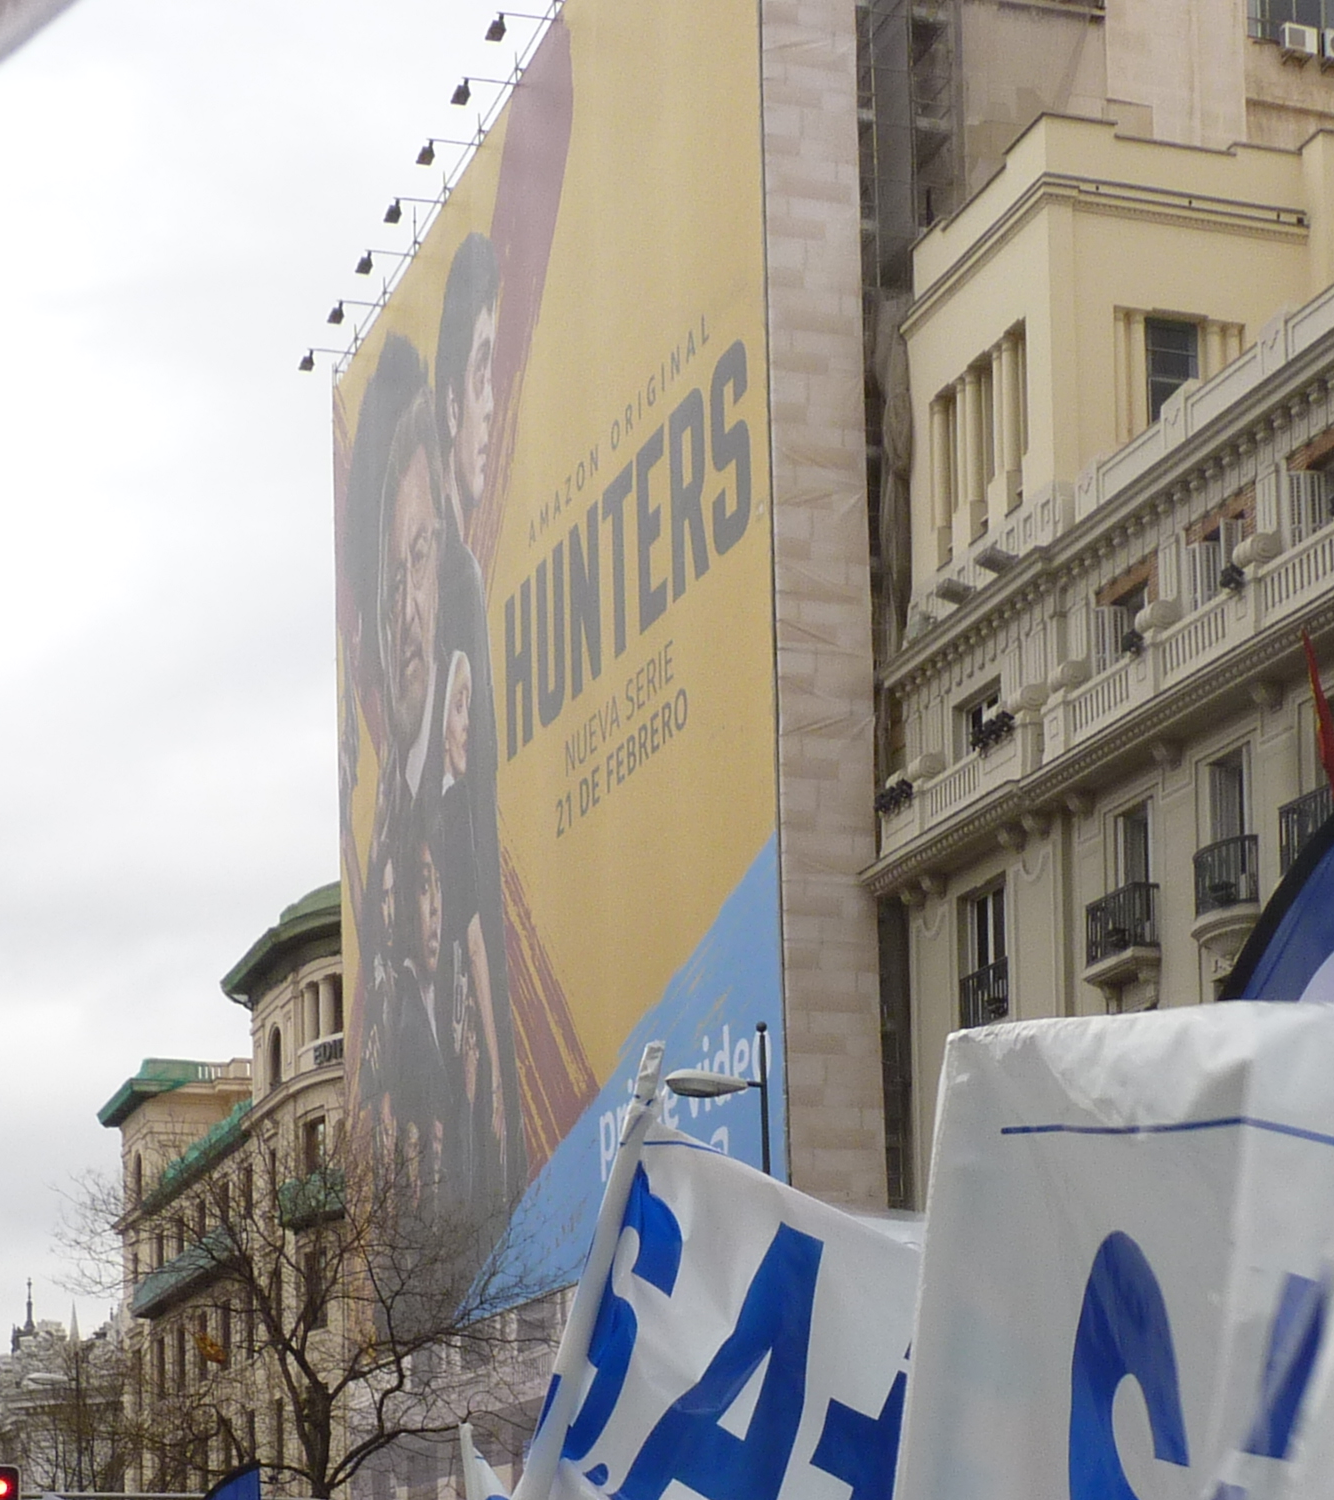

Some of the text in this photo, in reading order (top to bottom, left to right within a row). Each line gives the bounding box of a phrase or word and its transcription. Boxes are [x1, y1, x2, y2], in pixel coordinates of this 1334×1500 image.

[528, 313, 710, 548] AMAZON ORIGINAL
[504, 338, 752, 762] HUNTERS
[555, 687, 688, 839] 21 DE FEBRERO
[564, 639, 675, 777] NUEVA SERIE
[314, 1038, 344, 1066] EDI
